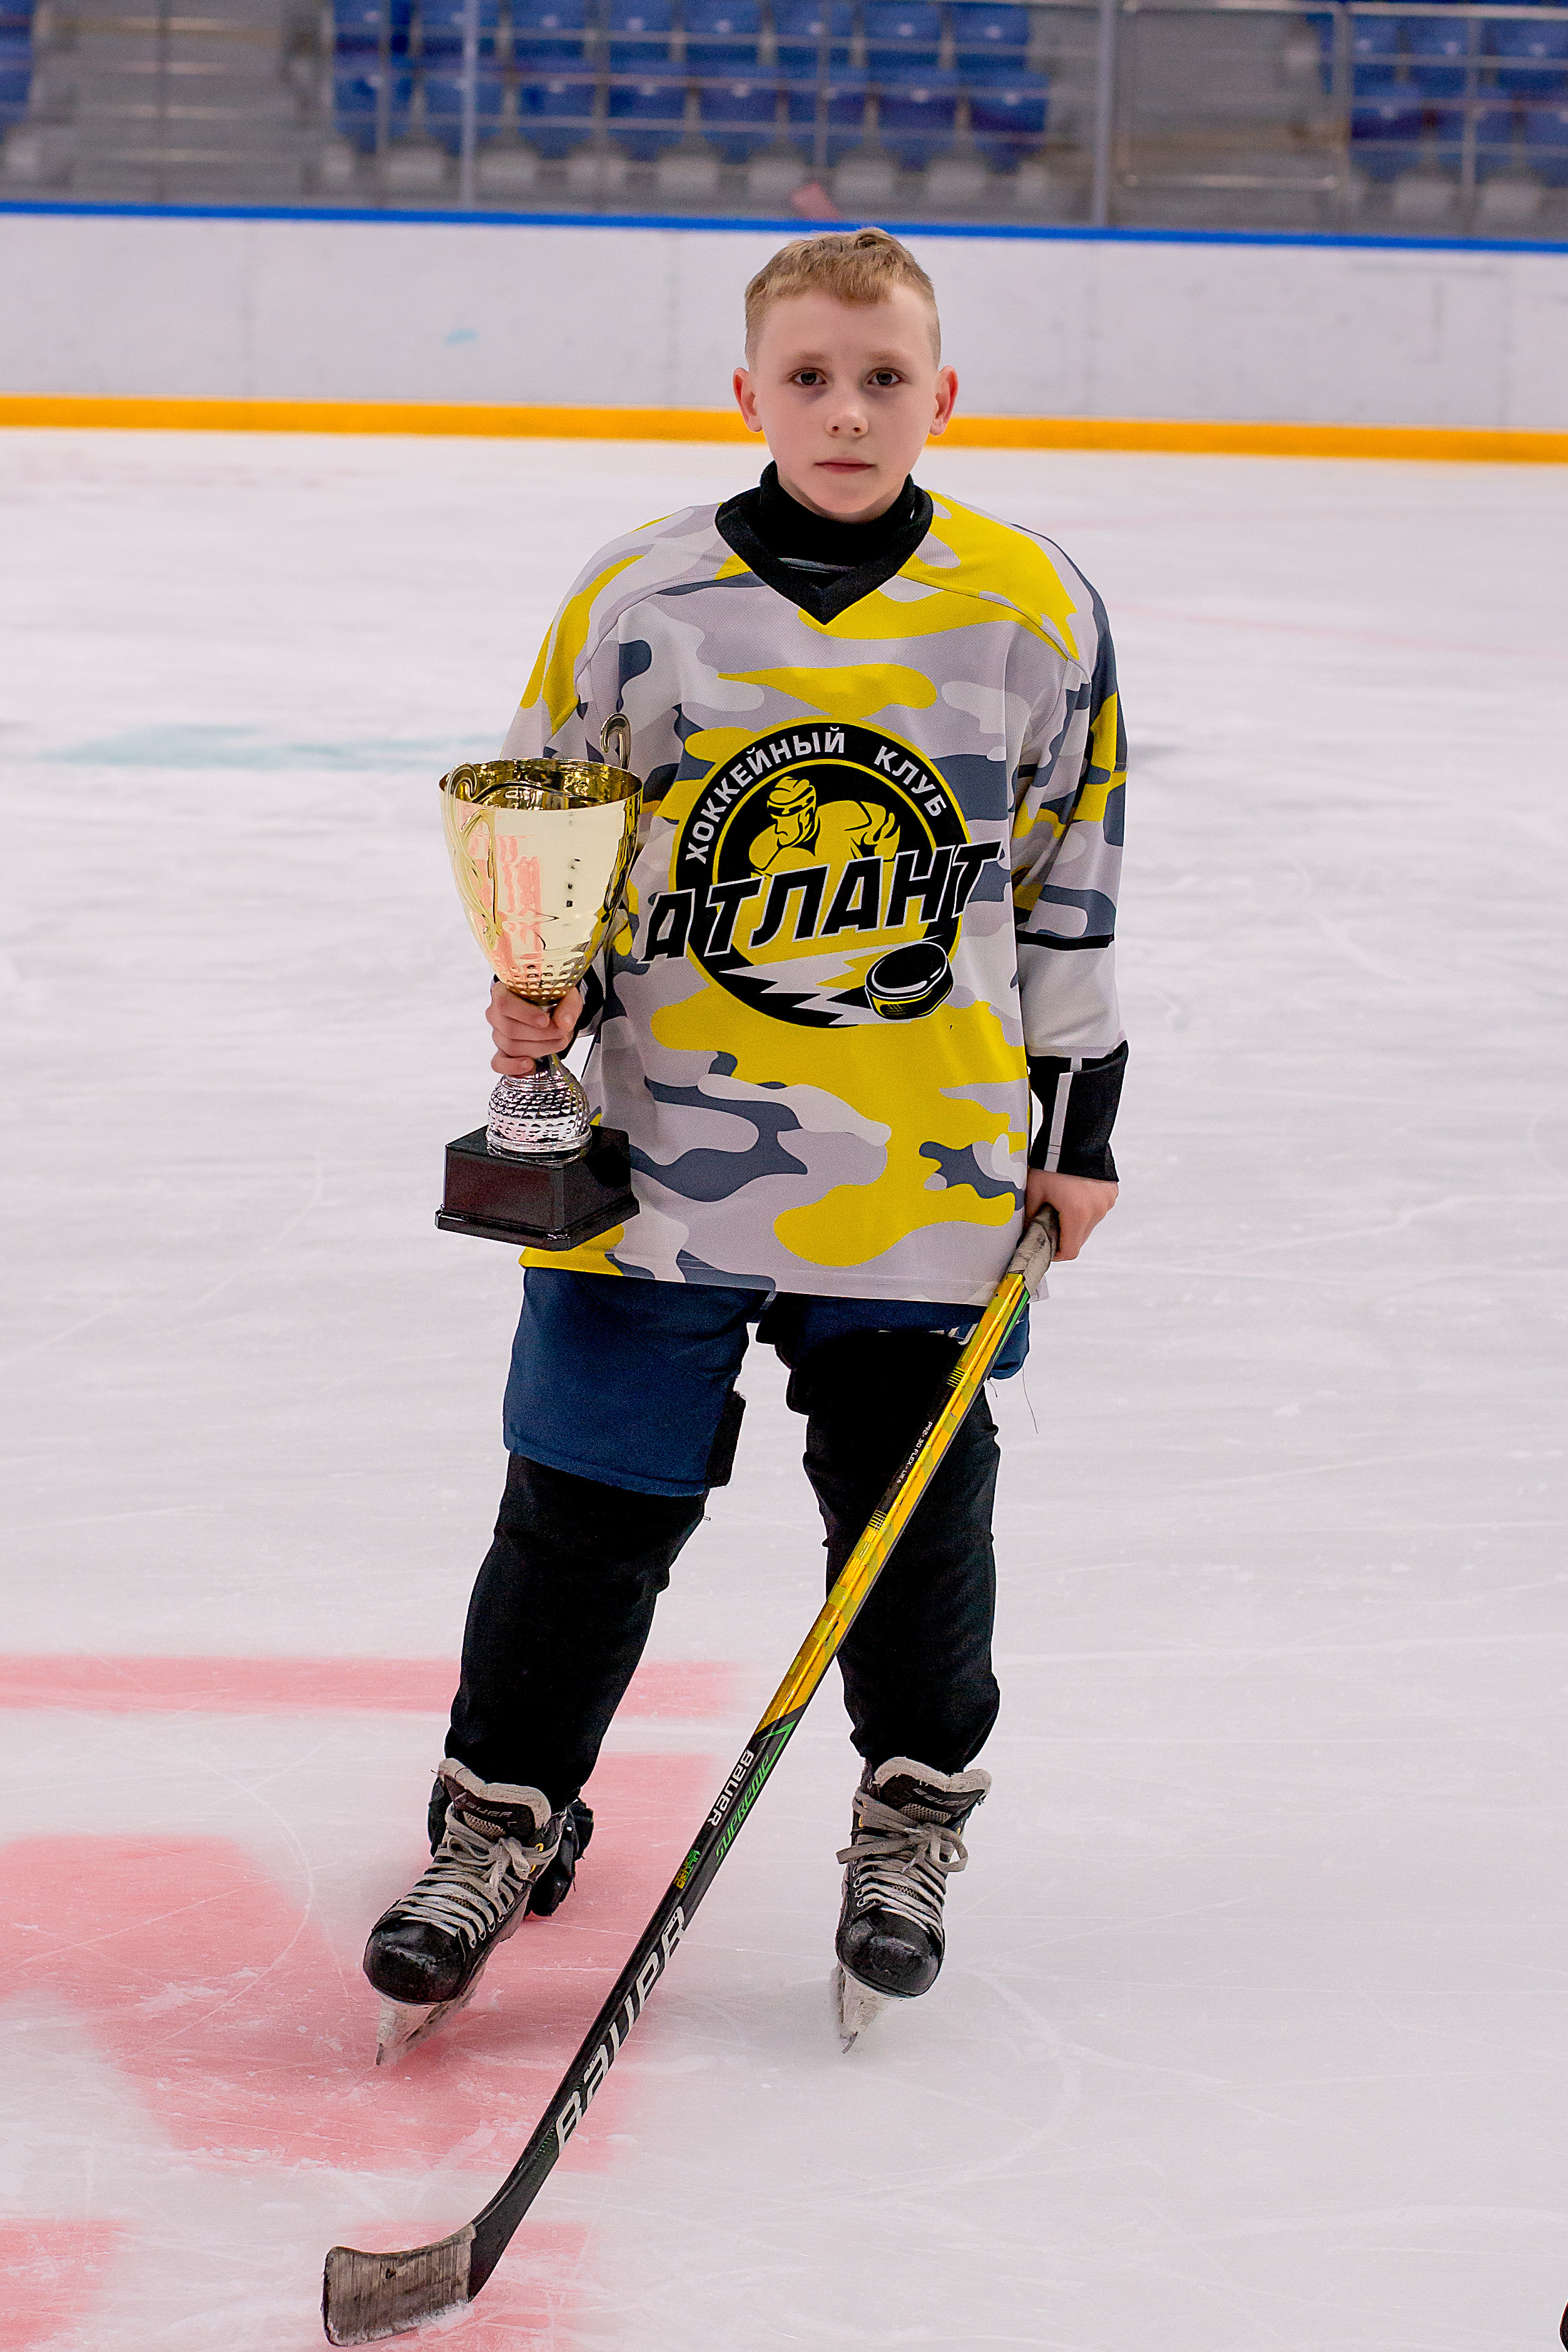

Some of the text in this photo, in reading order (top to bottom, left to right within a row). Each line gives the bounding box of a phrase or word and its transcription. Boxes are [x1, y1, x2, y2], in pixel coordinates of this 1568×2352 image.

[685, 727, 947, 864] ХОККЕЙНЫЙ КЛУБ
[636, 838, 1005, 965] АТЛАНТ
[906, 1448, 919, 1466] FLEX
[708, 1749, 755, 1826] BAUER
[716, 1753, 770, 1865] SUPREME
